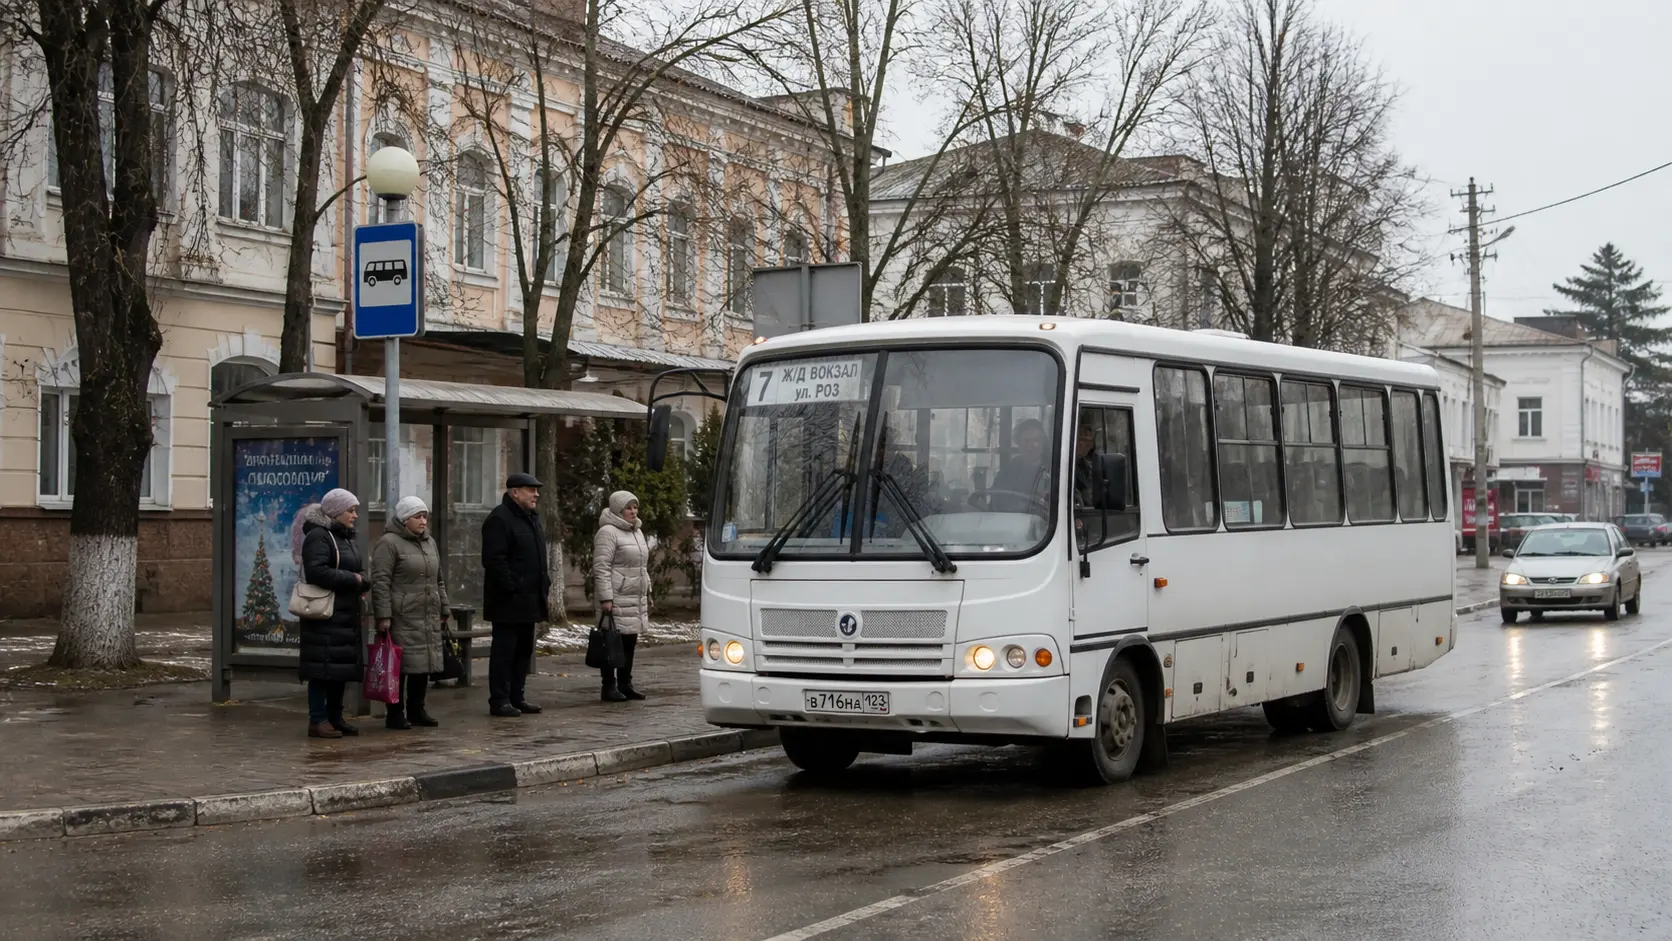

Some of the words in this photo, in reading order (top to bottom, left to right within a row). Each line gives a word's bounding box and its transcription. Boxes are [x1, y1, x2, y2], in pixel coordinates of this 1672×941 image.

[781, 366, 806, 384] Ж/Д
[809, 363, 858, 380] ВОКЗАЛ
[758, 371, 774, 402] 7
[794, 387, 812, 401] ул.
[815, 383, 840, 398] РОЗ
